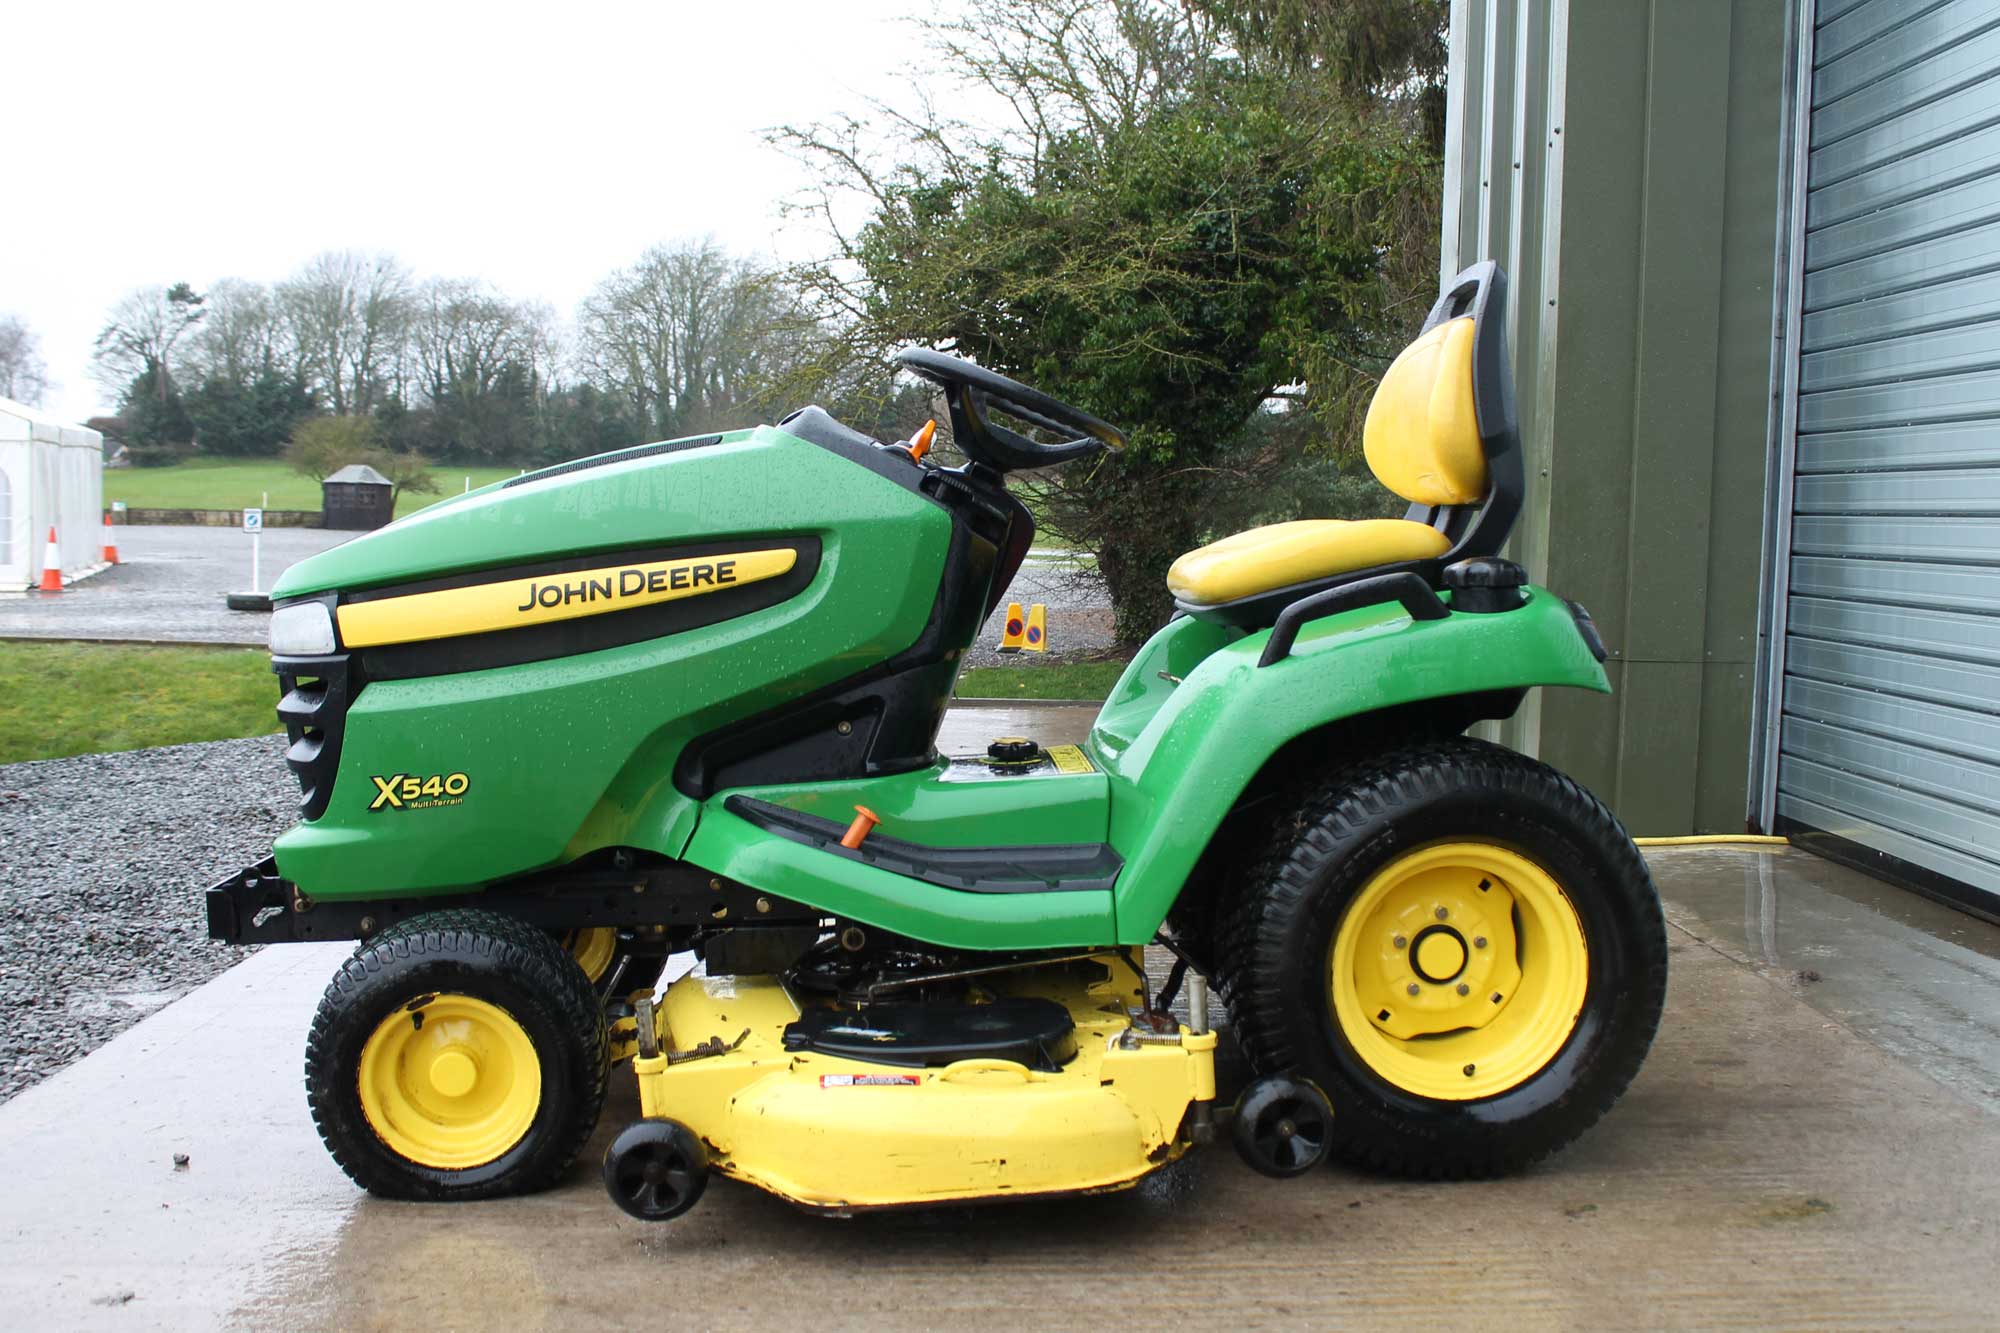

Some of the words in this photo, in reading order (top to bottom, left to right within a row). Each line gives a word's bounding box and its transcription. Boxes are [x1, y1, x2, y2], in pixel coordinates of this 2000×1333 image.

[518, 577, 612, 612] JOHN
[619, 560, 737, 598] DEERE
[369, 773, 470, 811] X540
